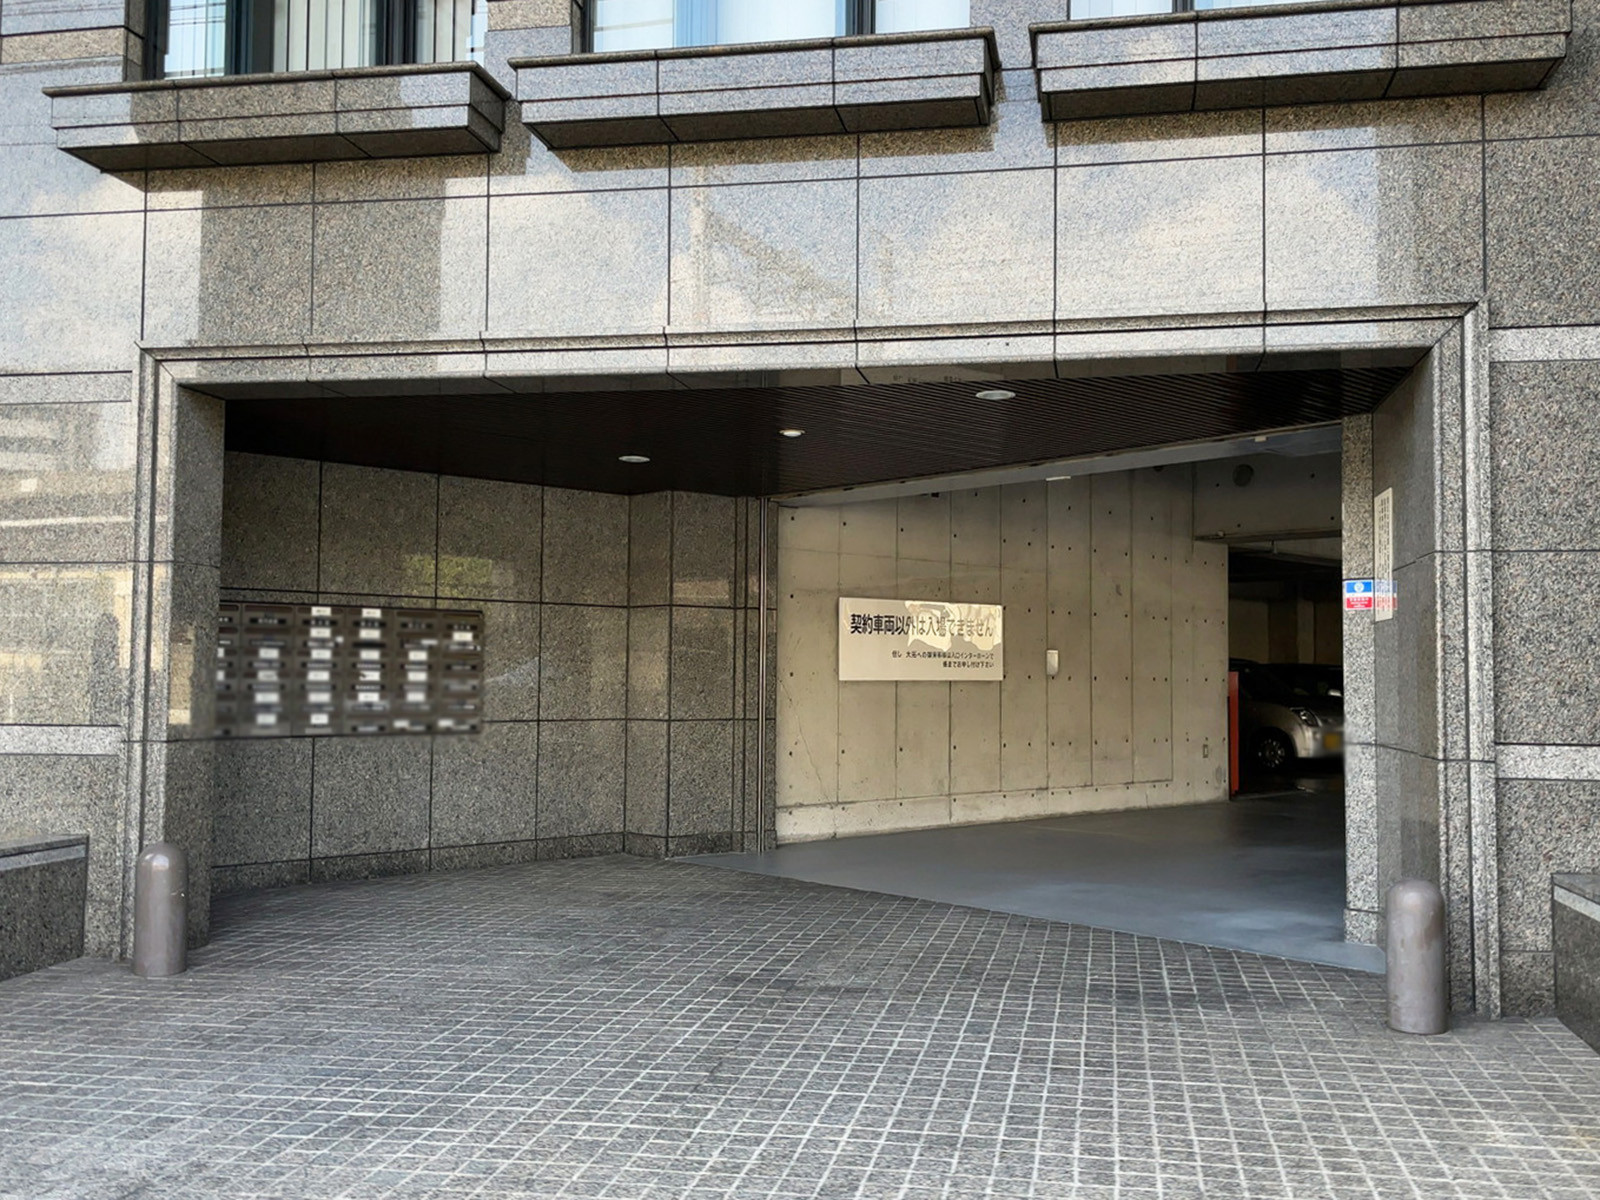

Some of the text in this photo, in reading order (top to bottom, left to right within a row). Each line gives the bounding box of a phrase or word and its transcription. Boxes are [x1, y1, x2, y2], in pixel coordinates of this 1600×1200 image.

[850, 614, 993, 637] 契約車両以外は入場できません
